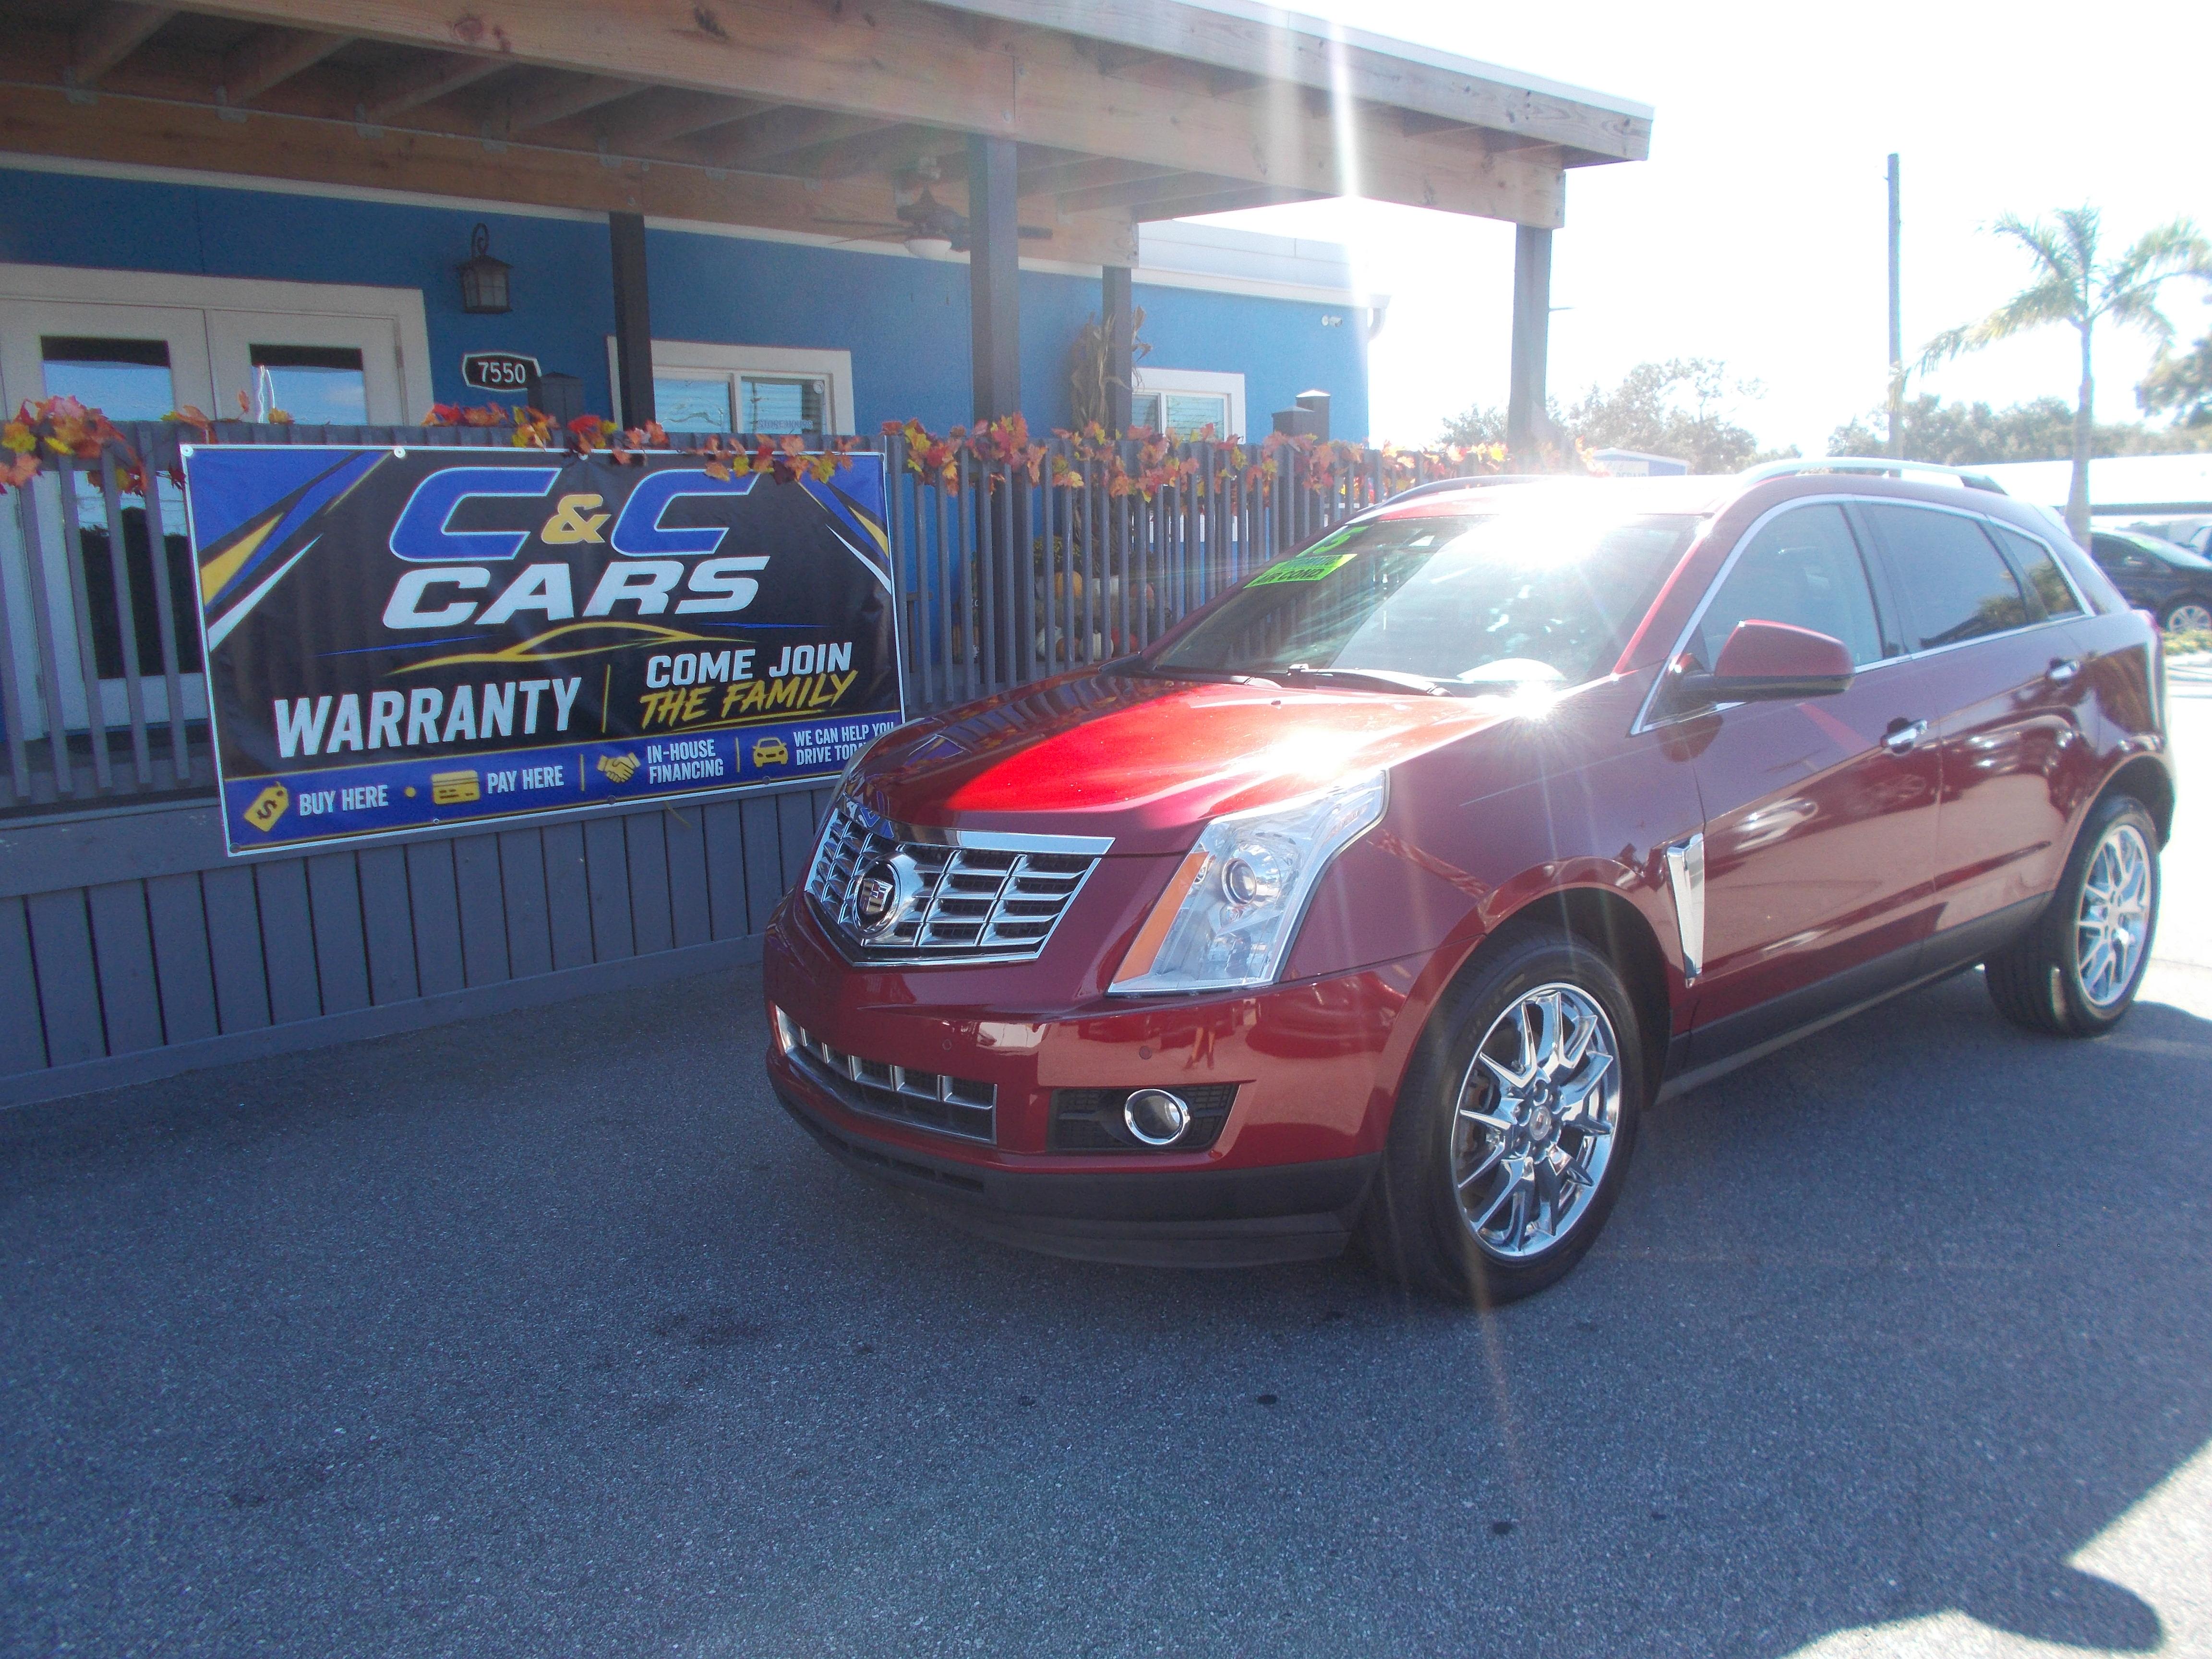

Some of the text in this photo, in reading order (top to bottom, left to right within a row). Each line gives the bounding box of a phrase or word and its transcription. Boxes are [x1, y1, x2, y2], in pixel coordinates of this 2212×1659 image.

[478, 362, 526, 384] 7550
[758, 420, 813, 429] STORE HOURS
[383, 555, 770, 629] CARS
[646, 642, 853, 688] COME JOIN
[639, 670, 858, 729] THE FAMILY
[274, 677, 582, 757] WARRANTY
[793, 730, 812, 747] WE
[815, 728, 839, 745] CAN
[841, 724, 869, 742] HELP
[647, 739, 716, 764] IN-HOUSE
[796, 742, 866, 766] DRIVE TOD
[487, 765, 565, 794] PAY HERE
[649, 758, 724, 784] FINANCING
[299, 784, 388, 816] BUY HERE
